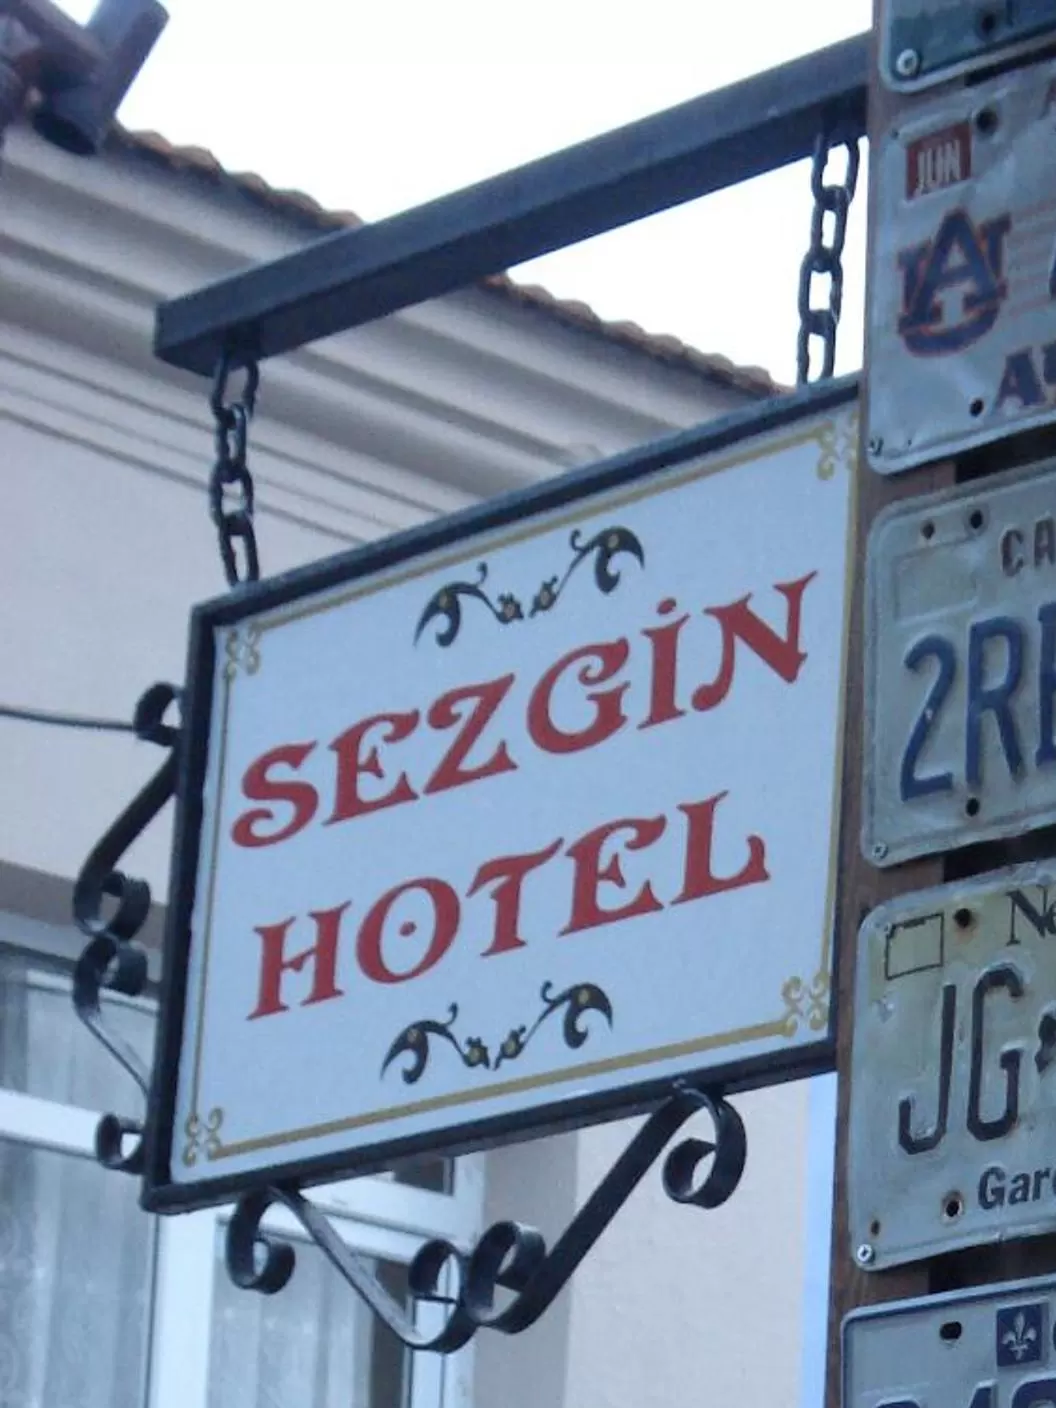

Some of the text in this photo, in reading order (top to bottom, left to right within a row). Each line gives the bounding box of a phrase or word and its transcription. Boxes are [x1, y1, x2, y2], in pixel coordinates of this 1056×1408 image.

[914, 138, 963, 197] JUN
[230, 570, 818, 848] SEZGİN
[246, 790, 770, 1021] HOTEL
